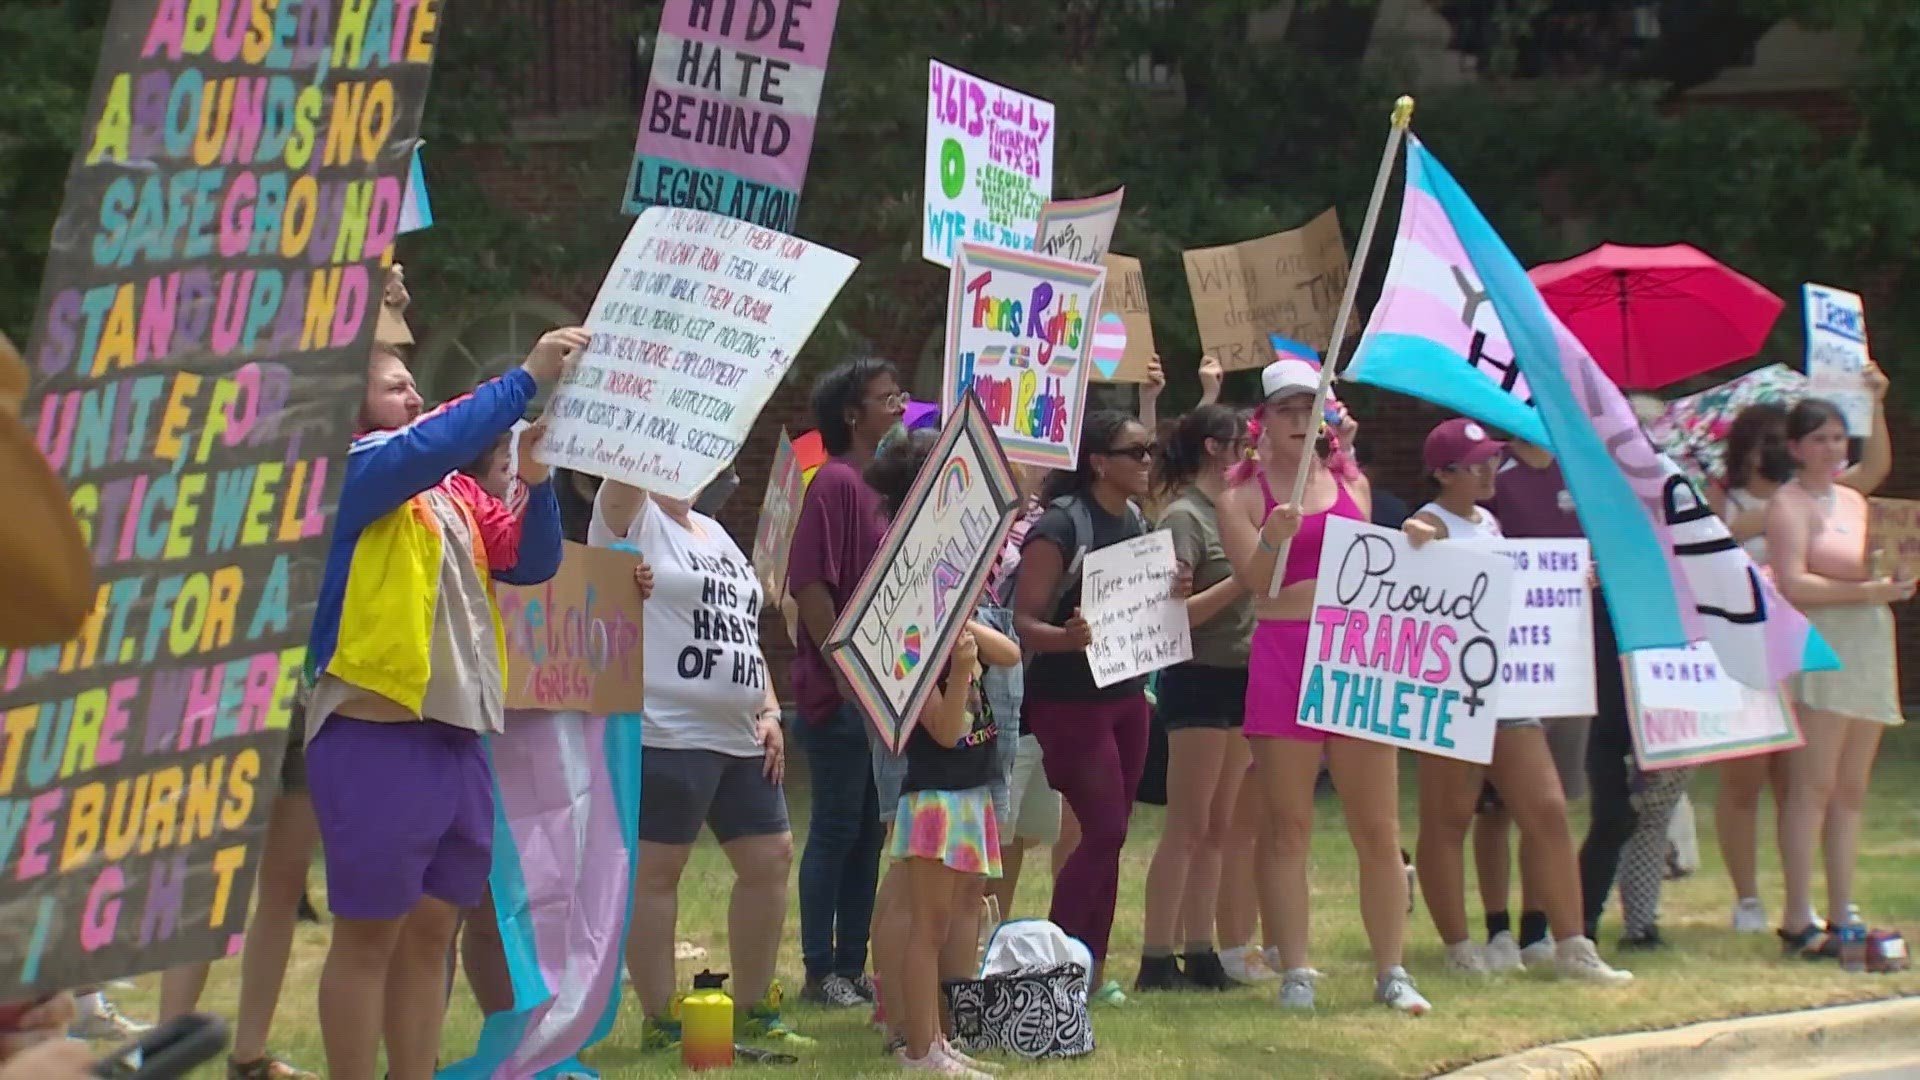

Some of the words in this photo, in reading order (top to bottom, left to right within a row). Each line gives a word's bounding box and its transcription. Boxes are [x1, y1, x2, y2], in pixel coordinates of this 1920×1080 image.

[676, 39, 791, 106] HATE
[648, 89, 792, 158] BEHIND
[1028, 102, 1050, 144] by
[632, 160, 799, 233] LEGISLATION
[703, 283, 734, 311] THEN
[724, 255, 759, 282] THEN
[967, 271, 1023, 338] Trans
[1026, 281, 1083, 366] Rights
[666, 386, 737, 423] NUTRITION
[1013, 368, 1068, 443] Rights
[931, 504, 994, 633] ALL
[1336, 533, 1491, 634] Proud
[1538, 551, 1579, 572] NEWS
[247, 554, 290, 640] A
[692, 609, 760, 647] HABIT
[702, 577, 739, 609] HAS
[746, 587, 759, 617] A
[1524, 587, 1583, 609] ABBOTT
[677, 645, 723, 681] OF
[1314, 604, 1458, 684] TRANS
[1650, 661, 1718, 683] WOMEN
[1299, 663, 1462, 750] ATHLETE
[58, 748, 261, 874] BURNS
